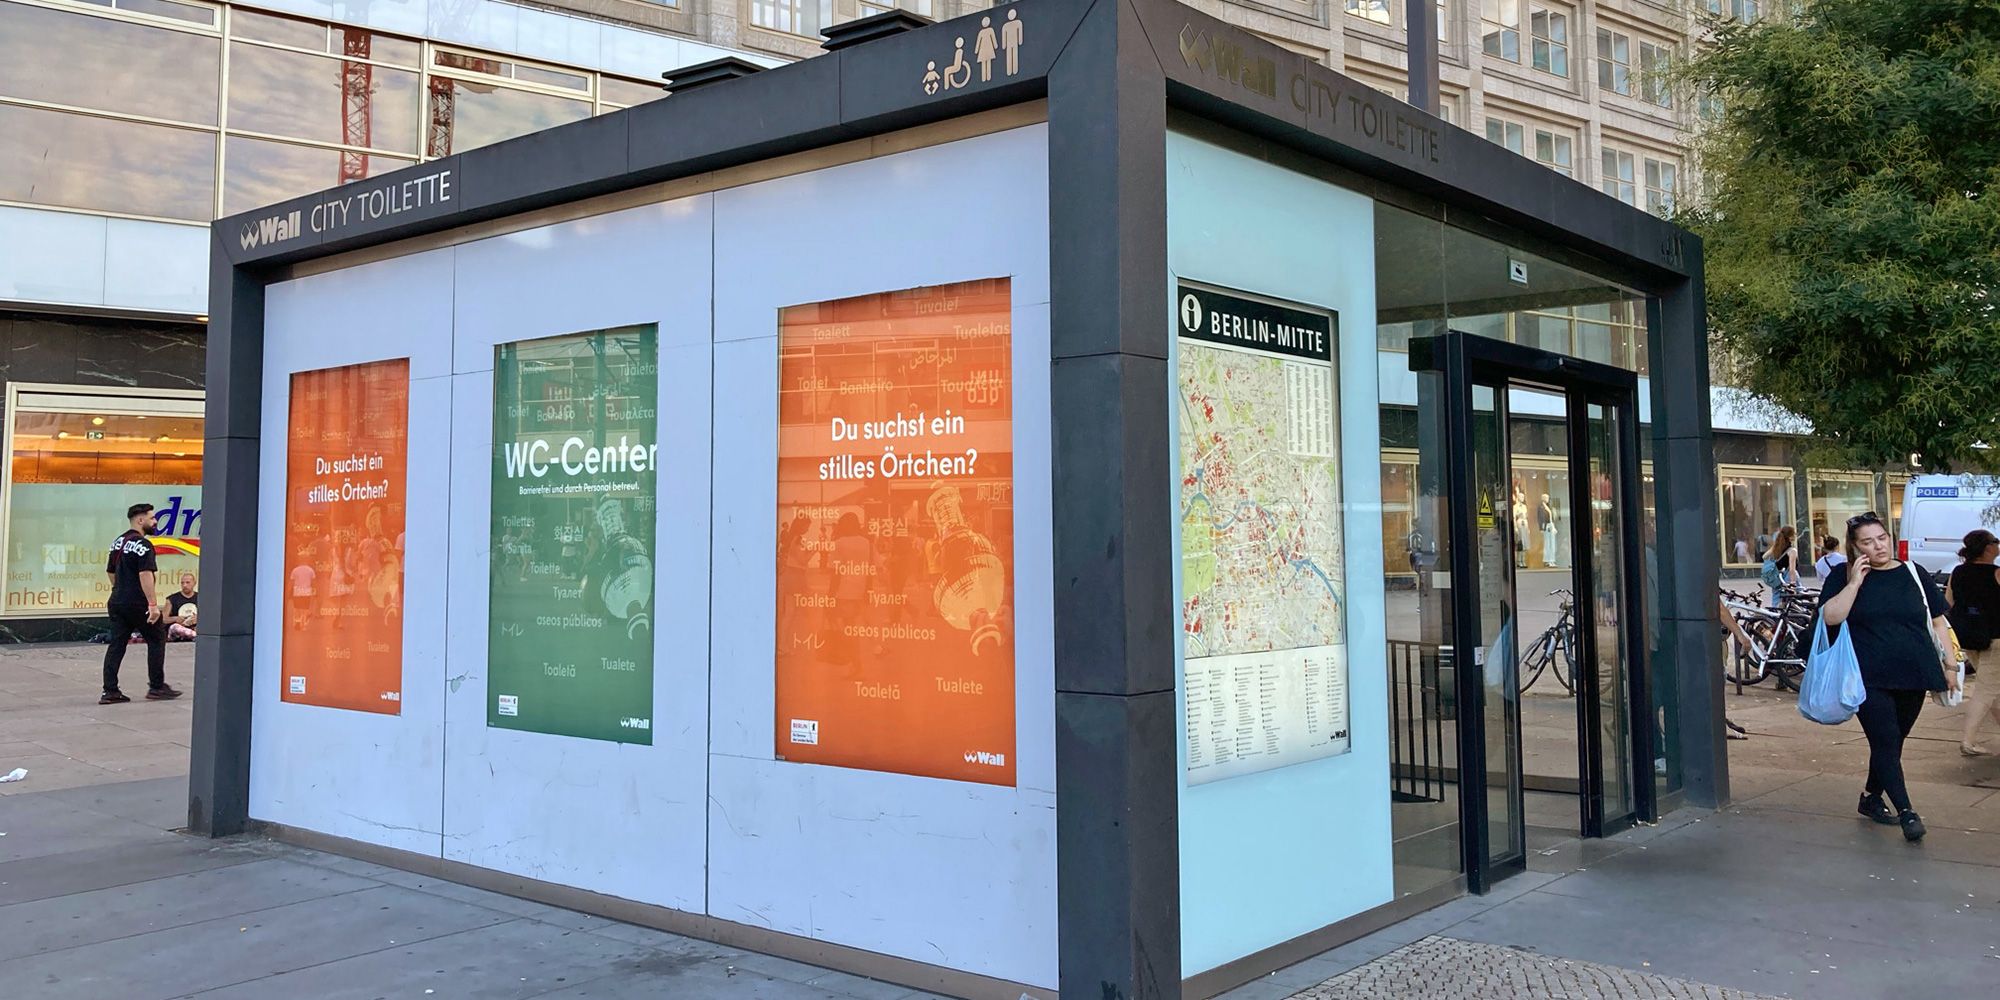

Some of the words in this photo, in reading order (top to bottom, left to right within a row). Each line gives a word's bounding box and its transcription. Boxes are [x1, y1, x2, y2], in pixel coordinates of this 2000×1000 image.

[1211, 33, 1276, 98] Wall
[1291, 73, 1341, 124] CITY
[1348, 95, 1439, 164] TOILETTE
[260, 210, 301, 245] Wall
[310, 197, 353, 233] CITY
[358, 170, 451, 221] TOILETTE
[812, 324, 851, 341] Toalett
[1210, 311, 1323, 353] BERLIN-MITTE
[839, 377, 894, 396] Banheiro
[831, 417, 858, 441] Du
[863, 412, 925, 440] suchst
[931, 408, 965, 435] ein
[316, 457, 331, 475] Du
[333, 454, 367, 474] suchst
[369, 451, 383, 470] ein
[504, 435, 658, 478] WC-Center
[818, 454, 875, 481] stilles
[880, 445, 978, 478] Örtchen?
[308, 484, 339, 504] stilles
[342, 478, 388, 501] Örtchen?
[519, 485, 551, 496] Barrierefrei
[552, 484, 563, 494] und
[564, 484, 582, 493] durch
[583, 482, 611, 492] Personal
[612, 481, 640, 491] betreut.
[1917, 488, 1958, 496] POLIZEI
[791, 506, 841, 519] Toilettes
[502, 515, 536, 528] Toilettes
[867, 517, 909, 538] 화장실
[800, 537, 836, 552] Sanita
[530, 561, 561, 575] Toilette
[833, 560, 878, 576] Toilette
[553, 585, 583, 600] Туалет
[793, 592, 836, 608] Toaleta
[867, 590, 908, 608] Туалет
[536, 615, 561, 626] aseos
[562, 613, 603, 629] públicos
[844, 625, 879, 638] aseos
[881, 623, 936, 641] públicos
[793, 632, 825, 650] トイレ
[601, 657, 636, 672] Tualete
[935, 676, 984, 695] Tualete
[629, 717, 650, 729] Wall
[977, 751, 1005, 767] Wall
